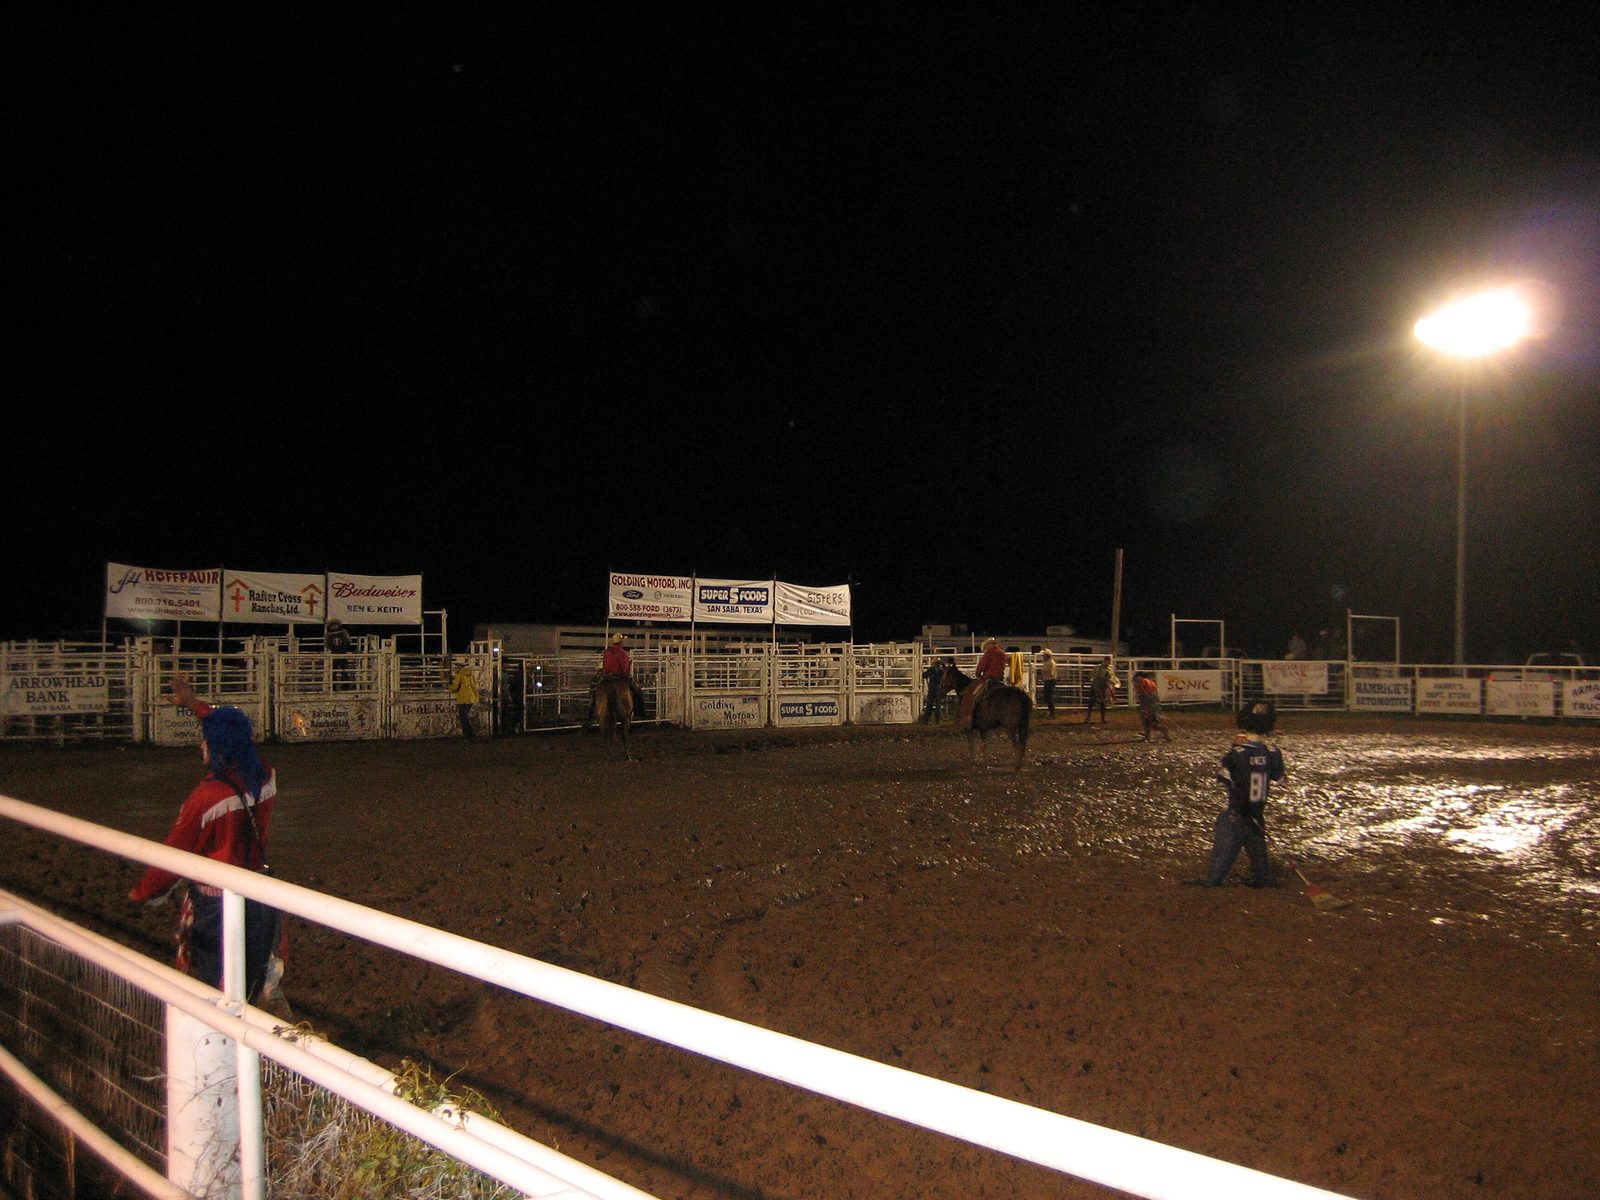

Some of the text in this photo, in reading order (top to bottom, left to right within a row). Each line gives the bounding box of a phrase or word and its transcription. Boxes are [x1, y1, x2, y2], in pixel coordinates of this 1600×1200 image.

[144, 570, 219, 585] HOFFPAUIR
[612, 575, 645, 588] GOLDING
[249, 590, 302, 604] Rafter Cross
[331, 582, 417, 600] Budweiser
[625, 590, 641, 599] Ford
[700, 589, 729, 601] SUPER
[739, 590, 767, 602] FOODS
[347, 605, 365, 613] BEN
[377, 606, 403, 614] KEITH
[707, 605, 721, 613] SAN
[743, 606, 763, 614] TEXAS
[10, 676, 106, 689] ARROWHEAD
[1167, 679, 1211, 690] SONIC
[26, 691, 70, 703] BANK
[781, 704, 804, 714] SUPER
[814, 704, 838, 715] FOODS
